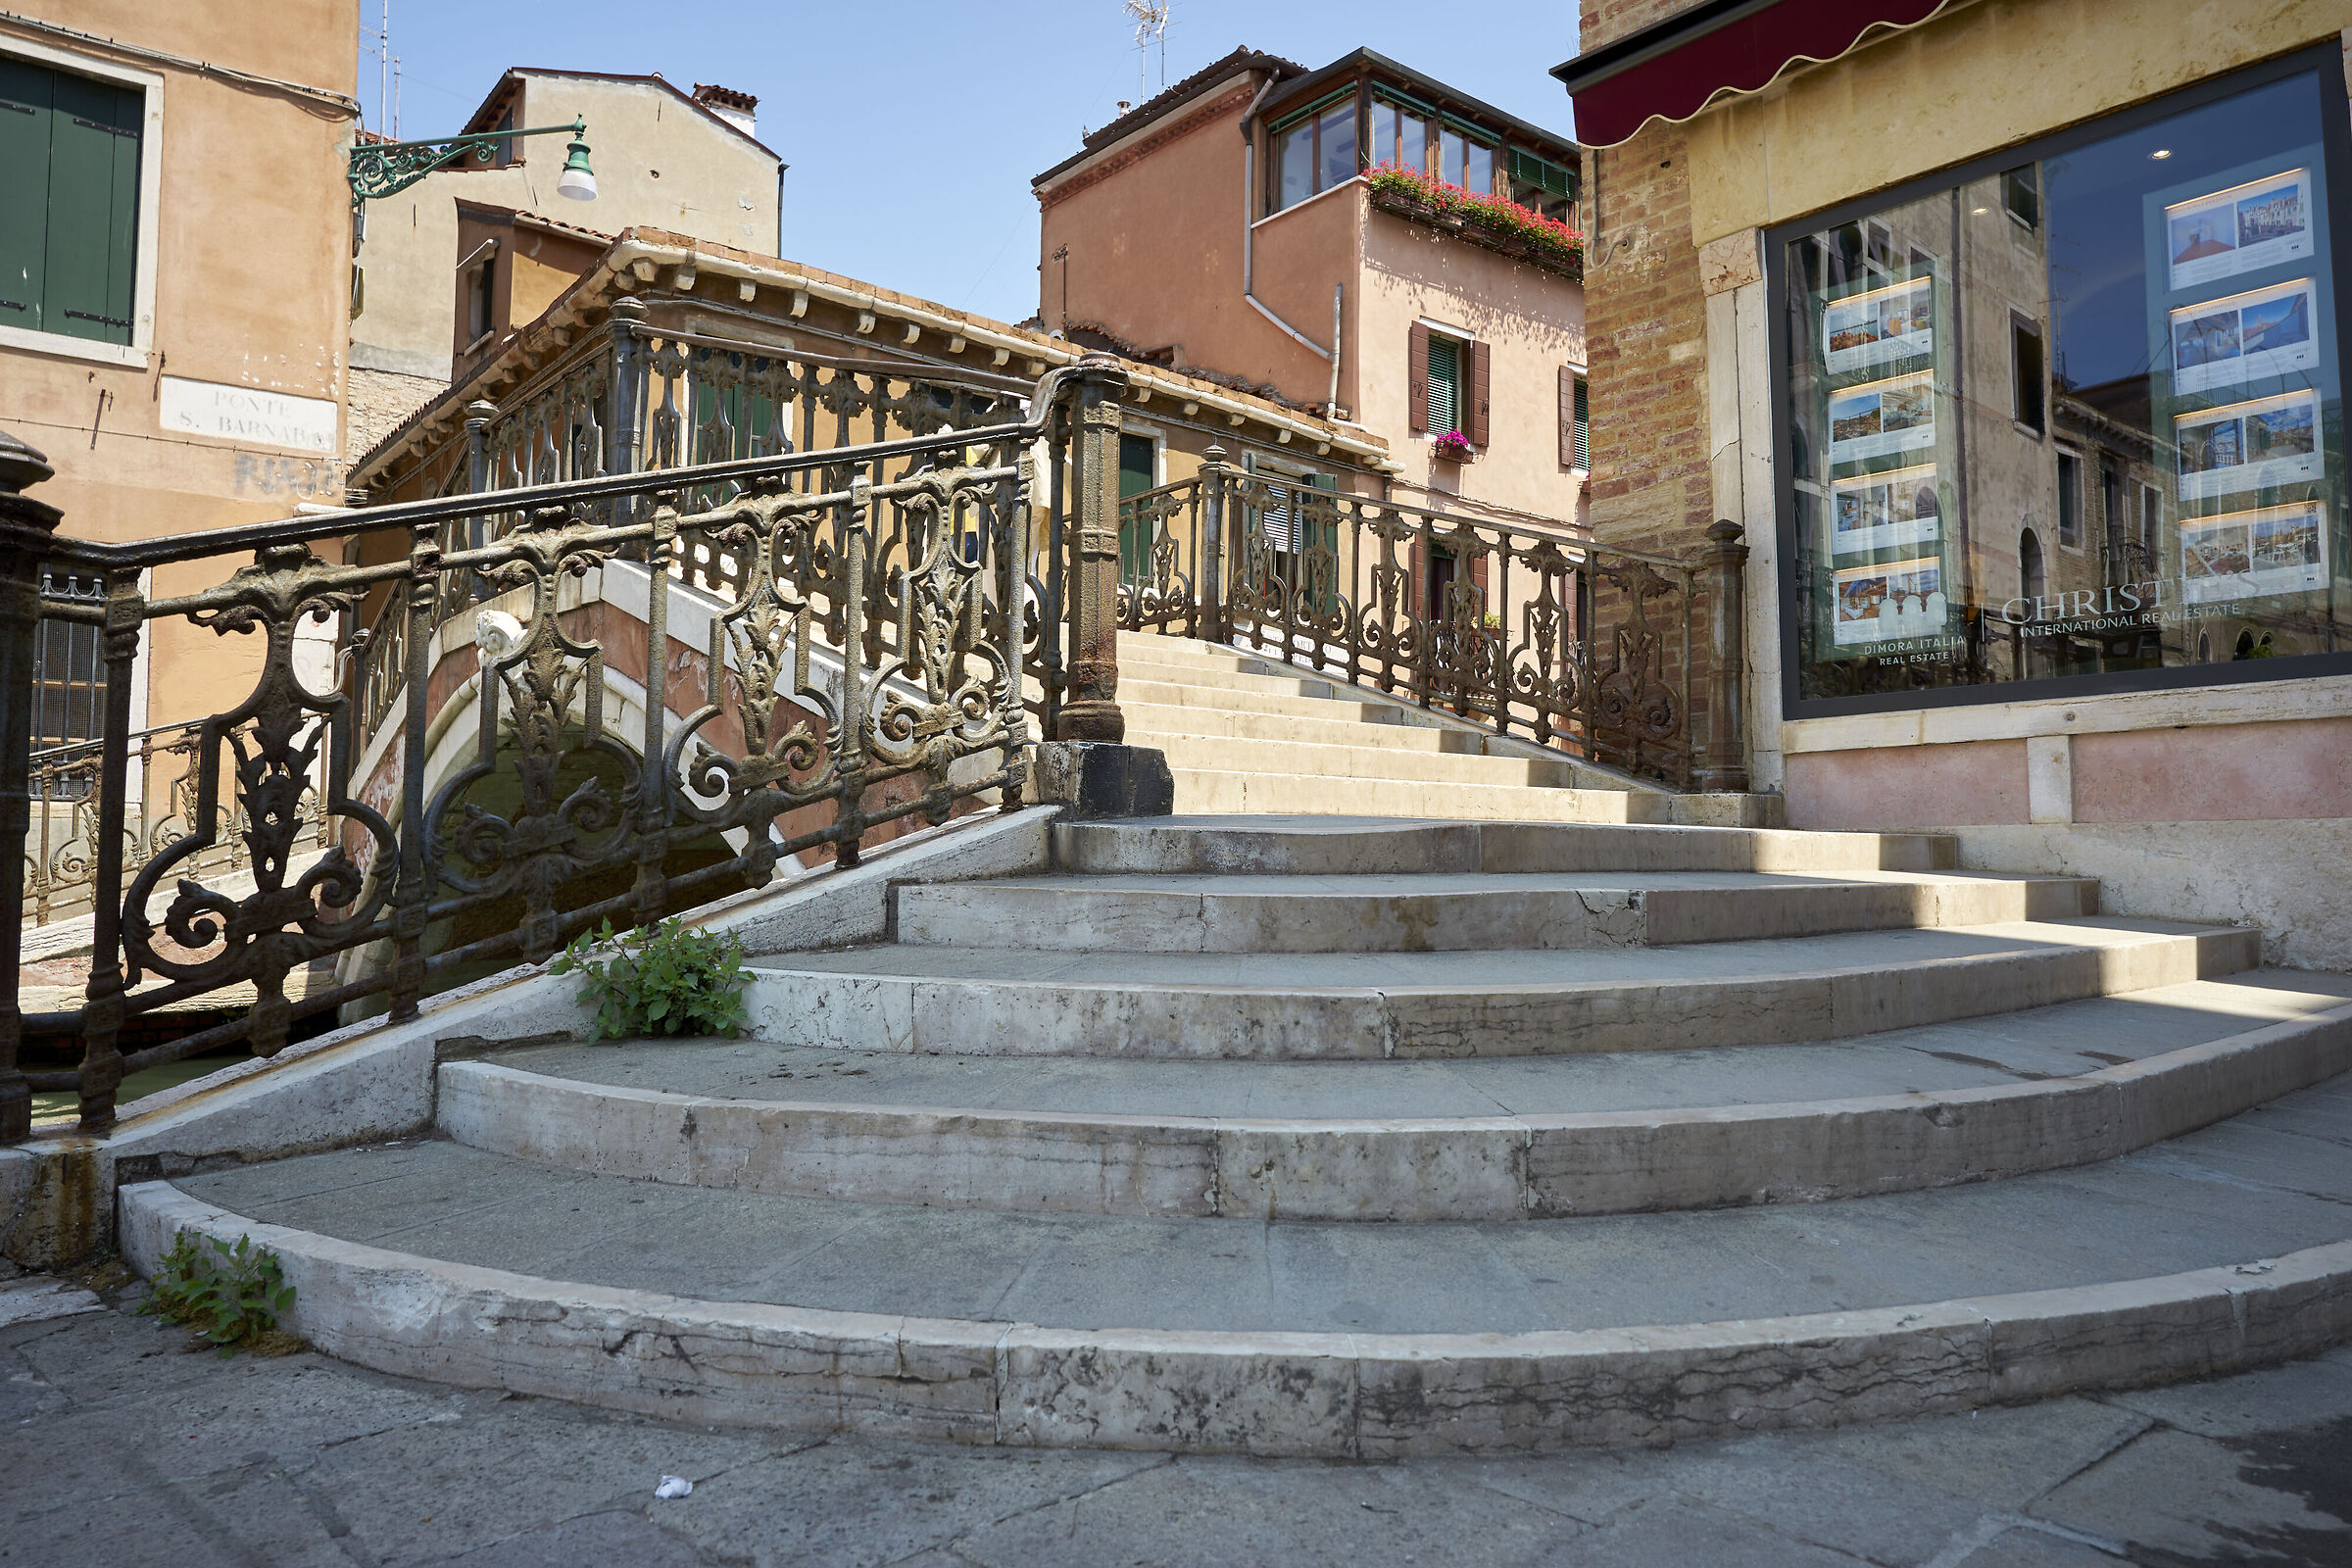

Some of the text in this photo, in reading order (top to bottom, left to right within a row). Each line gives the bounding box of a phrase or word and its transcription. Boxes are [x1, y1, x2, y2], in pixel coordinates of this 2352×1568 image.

[214, 390, 292, 418] PONTE
[179, 411, 200, 429] S.
[2021, 603, 2241, 637] INTERNATIONAL REAL ESTATE
[1864, 635, 1965, 656] DIMORA ITALIA
[1880, 652, 1949, 666] REAL ESTATE
